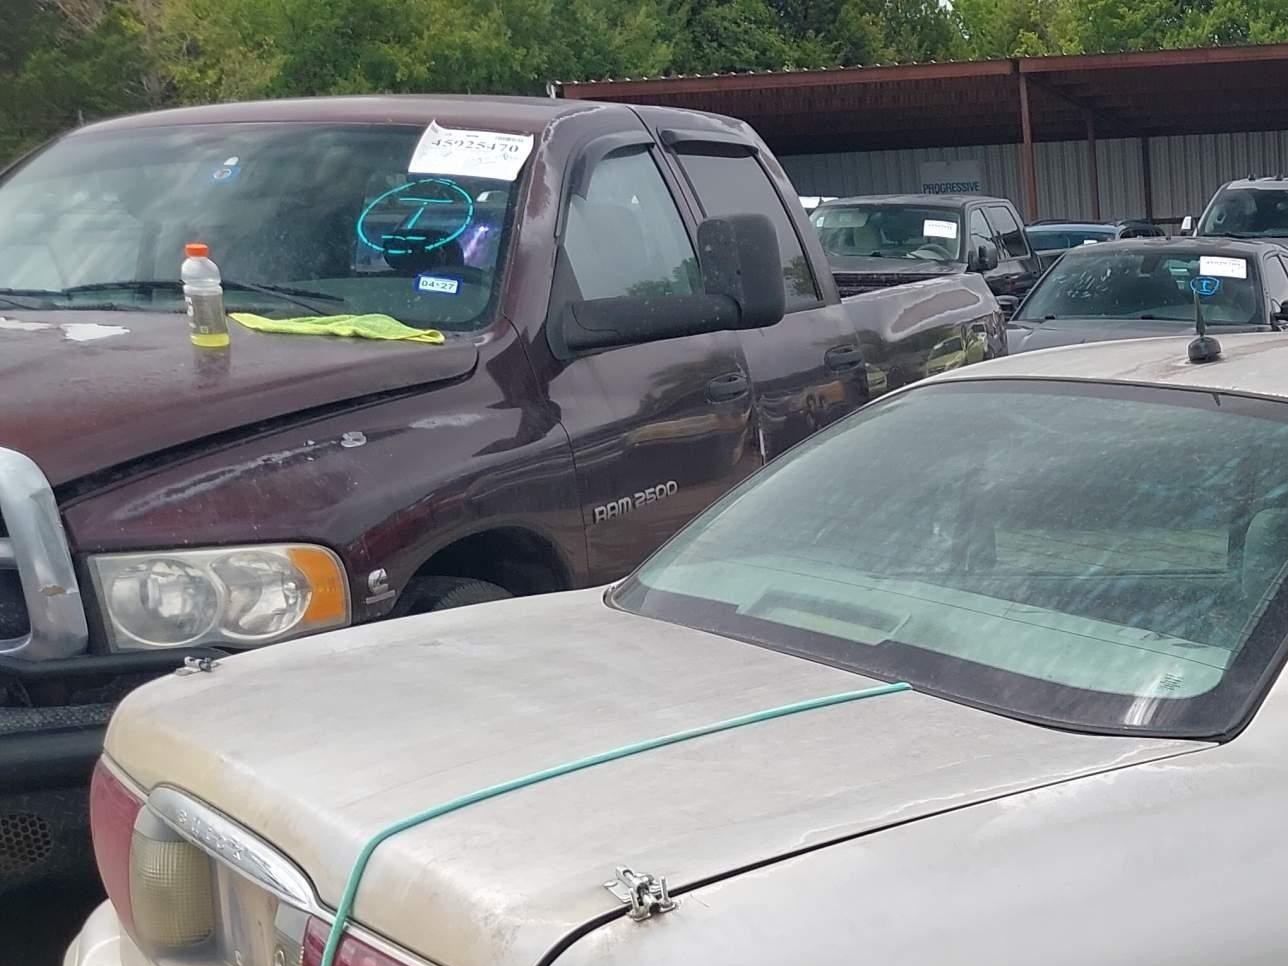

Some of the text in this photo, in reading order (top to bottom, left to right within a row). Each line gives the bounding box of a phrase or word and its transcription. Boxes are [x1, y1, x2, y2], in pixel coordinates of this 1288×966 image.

[922, 181, 980, 195] PROGRESSIVE
[594, 480, 679, 524] RAM 2500
